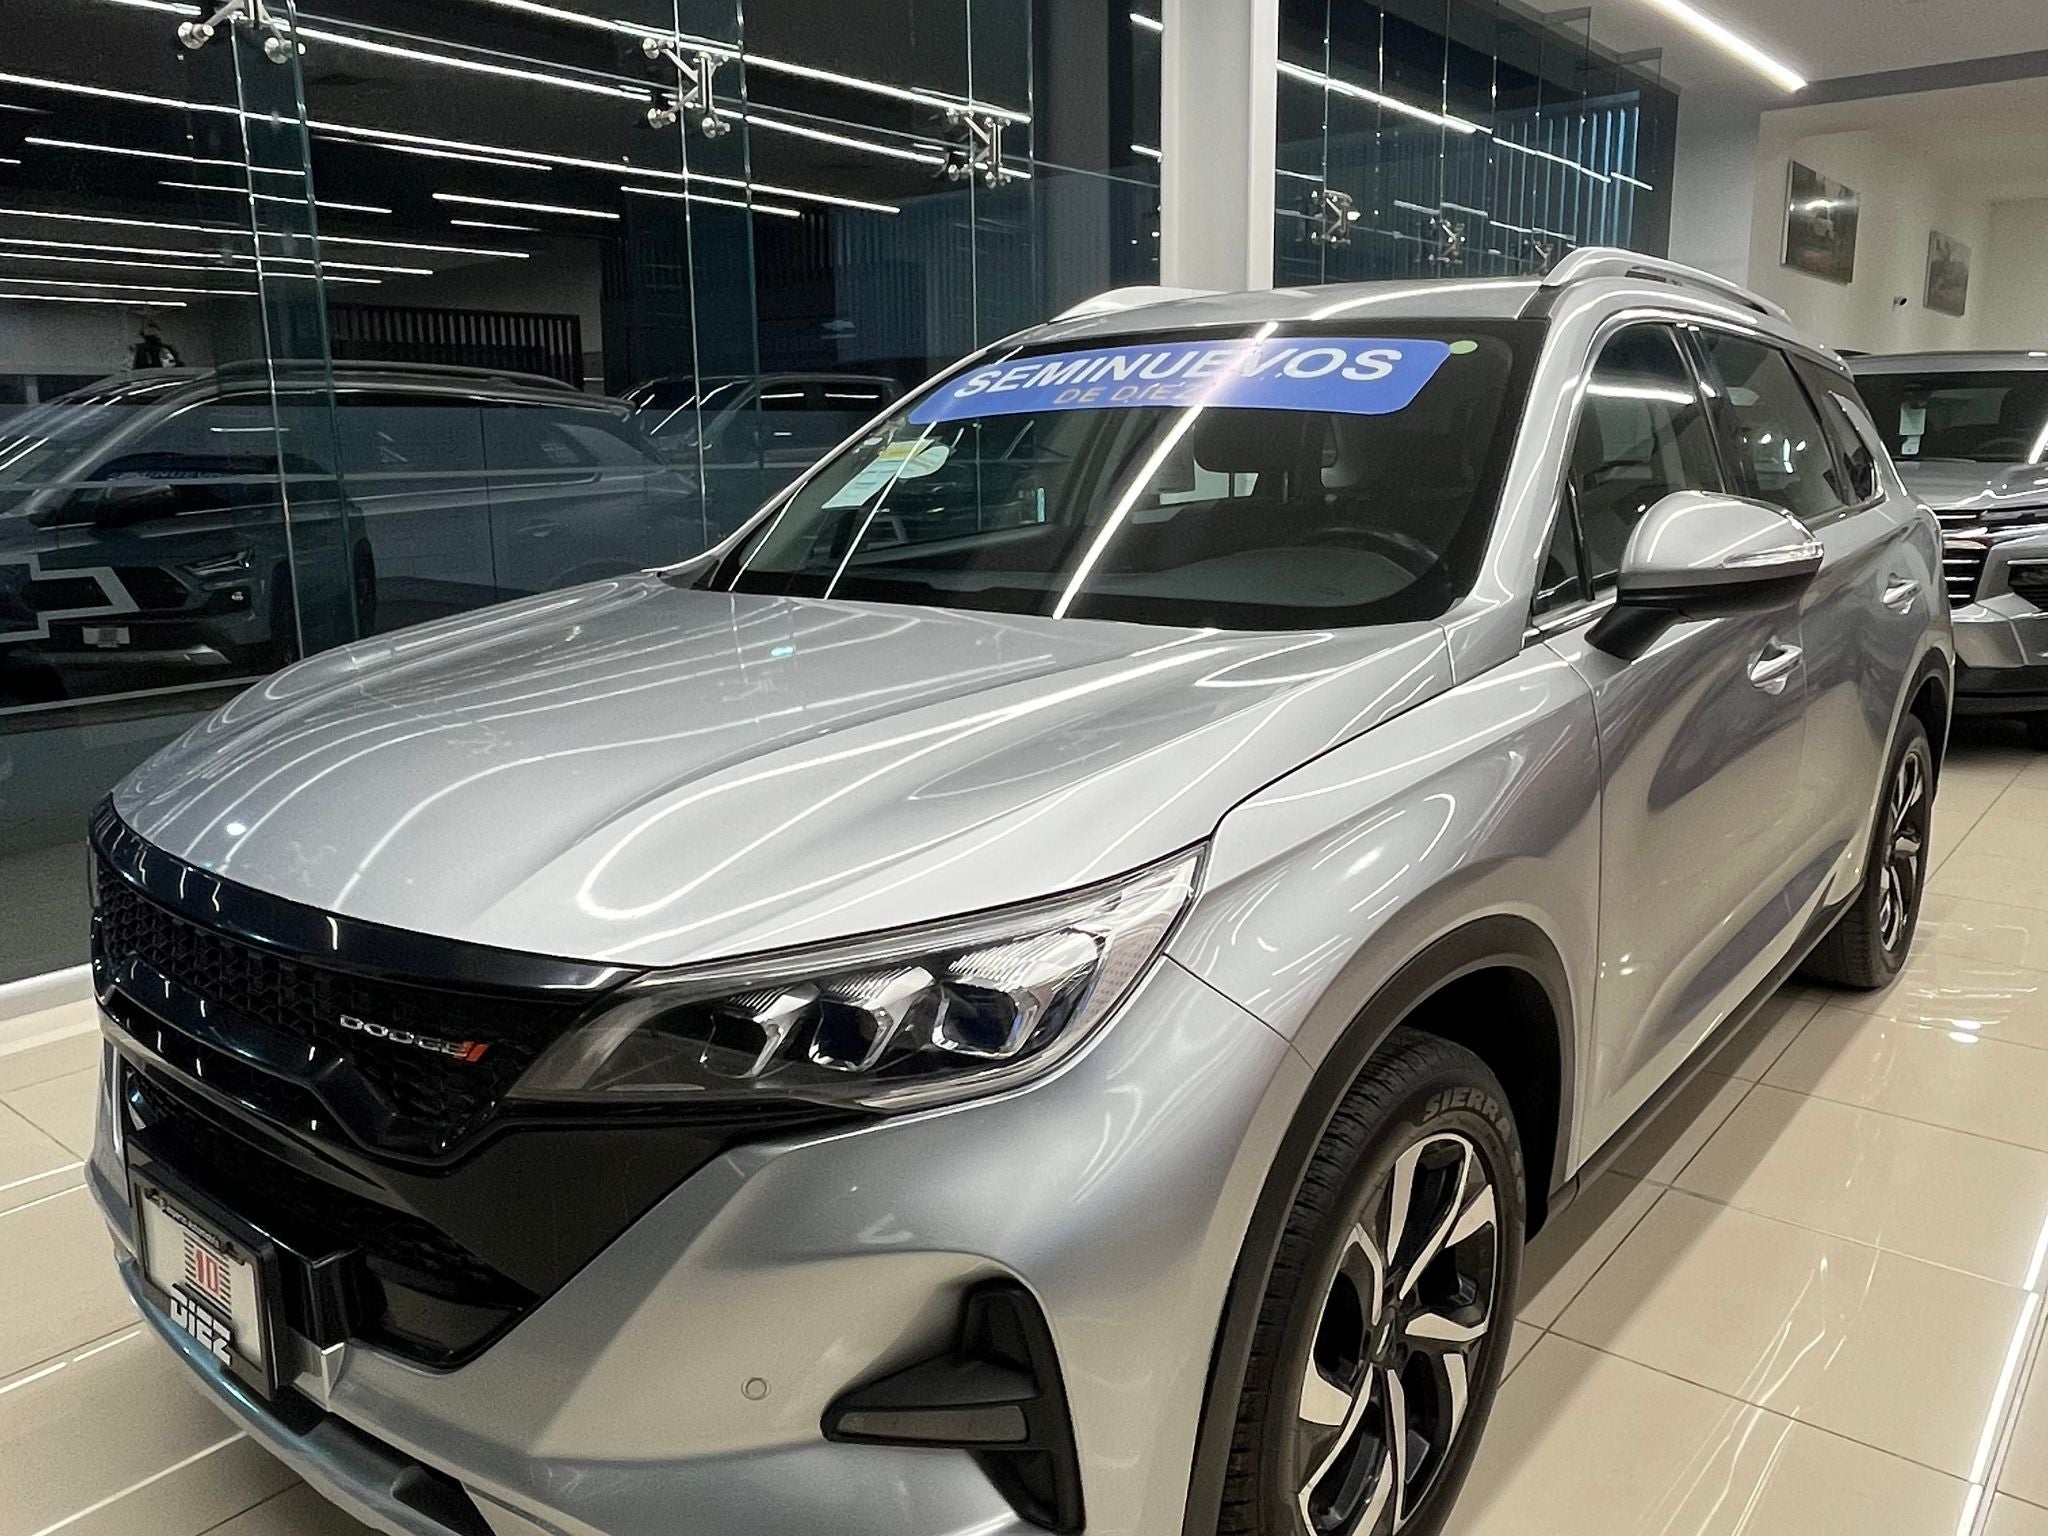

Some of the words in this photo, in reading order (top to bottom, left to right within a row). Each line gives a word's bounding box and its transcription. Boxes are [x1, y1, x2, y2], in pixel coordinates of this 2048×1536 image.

[954, 346, 1403, 400] SEMINUEVOS
[1054, 386, 1107, 404] DE
[1109, 384, 1203, 402] DIEZ
[340, 1014, 470, 1058] DODGE
[1421, 1086, 1512, 1142] SIERRA
[195, 1247, 220, 1297] 10
[170, 1284, 233, 1368] DIEZ
